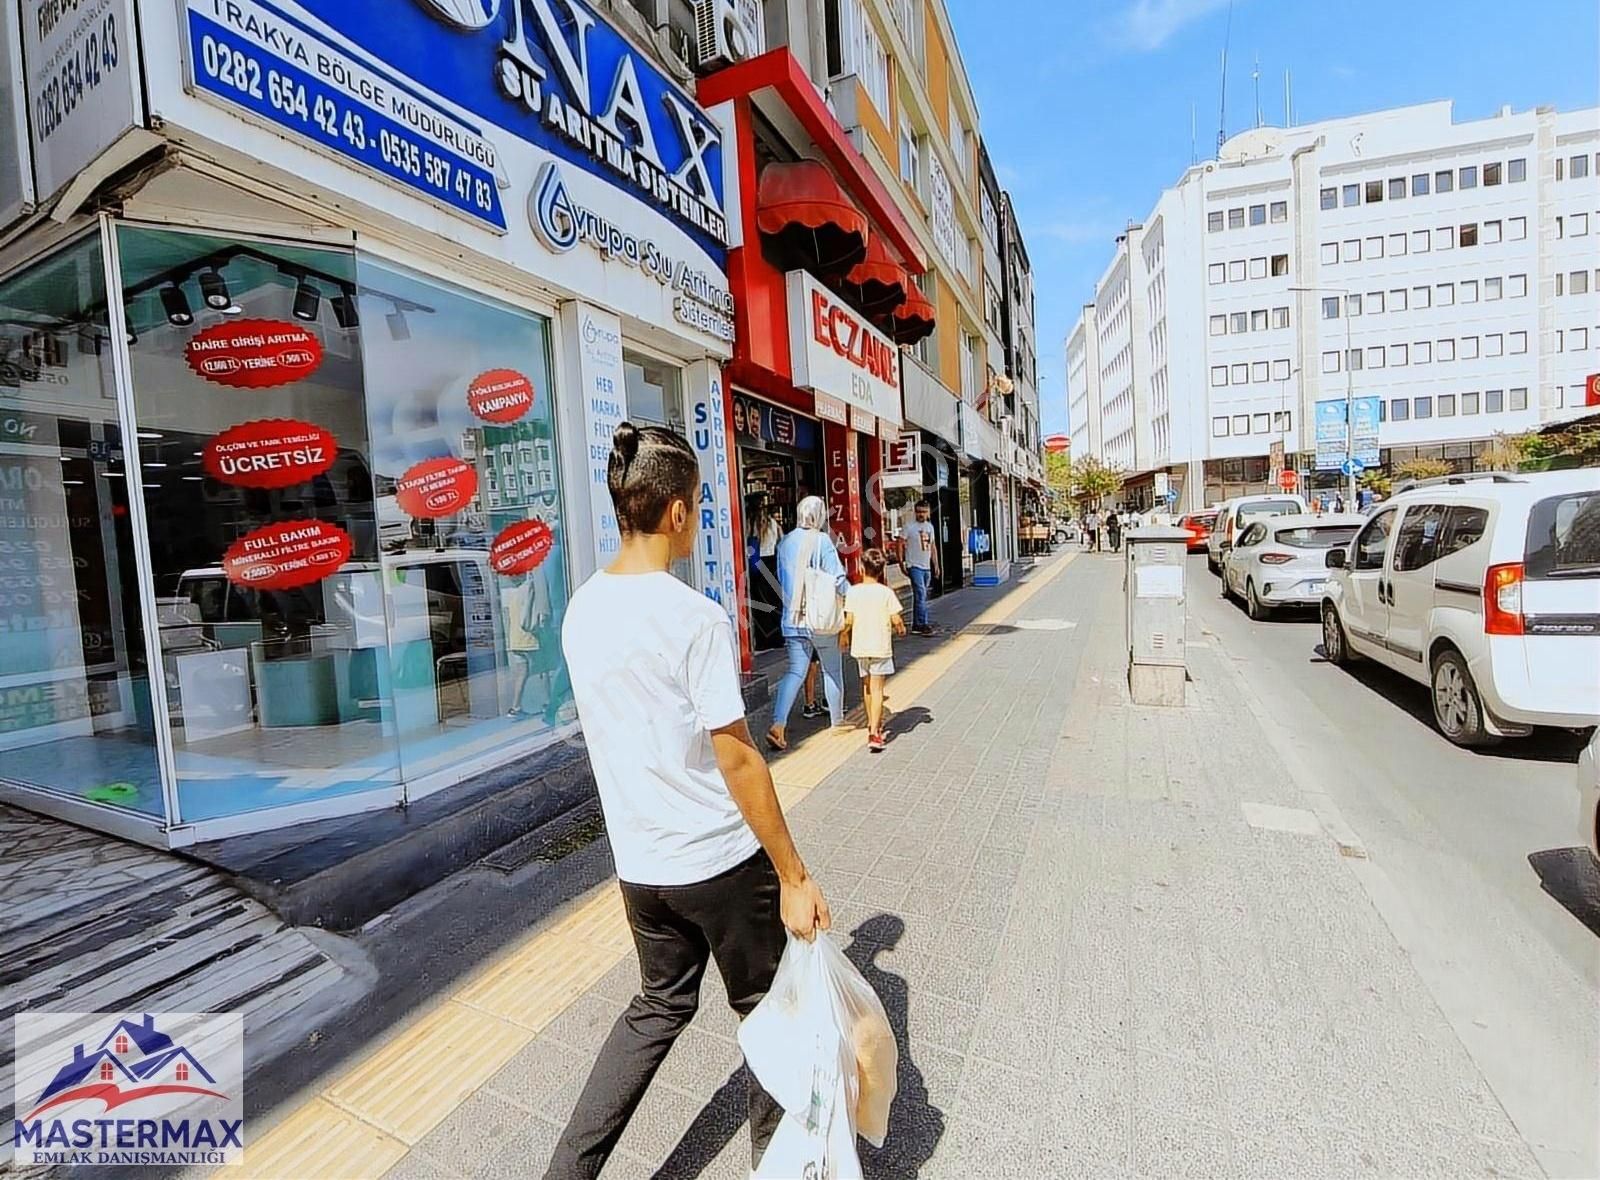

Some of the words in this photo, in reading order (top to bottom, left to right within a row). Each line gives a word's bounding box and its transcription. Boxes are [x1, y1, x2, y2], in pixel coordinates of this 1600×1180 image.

[61, 50, 84, 115] 654
[85, 32, 100, 90] 42
[102, 13, 118, 72] 43
[212, 0, 309, 66] TRAKYA
[317, 53, 385, 109] BÖLGE
[392, 96, 495, 168] MÜDÜRLÜĞÜ
[202, 35, 263, 100] 0282
[268, 69, 308, 122] 654
[313, 94, 338, 137] 42
[342, 110, 366, 150] 43
[380, 129, 421, 177] 0535
[424, 152, 450, 192] 587
[455, 169, 471, 201] 47
[475, 178, 492, 211] 83
[500, 56, 542, 112] SU
[548, 93, 637, 183] ARITMA
[538, 164, 638, 261] Avrupa
[646, 241, 673, 280] Su
[192, 338, 229, 351] DAİRE
[267, 332, 310, 345] ARITMA
[811, 288, 898, 389] ECZANE
[477, 391, 530, 415] KAMPANYA
[591, 398, 622, 418] MARKA
[596, 375, 614, 394] HER
[851, 371, 875, 406] EDA
[694, 401, 709, 451] SU
[220, 445, 326, 475] ÜCRETSİZ
[244, 535, 279, 552] FULL
[280, 525, 322, 543] BAKIM
[699, 481, 723, 606] ARITM
